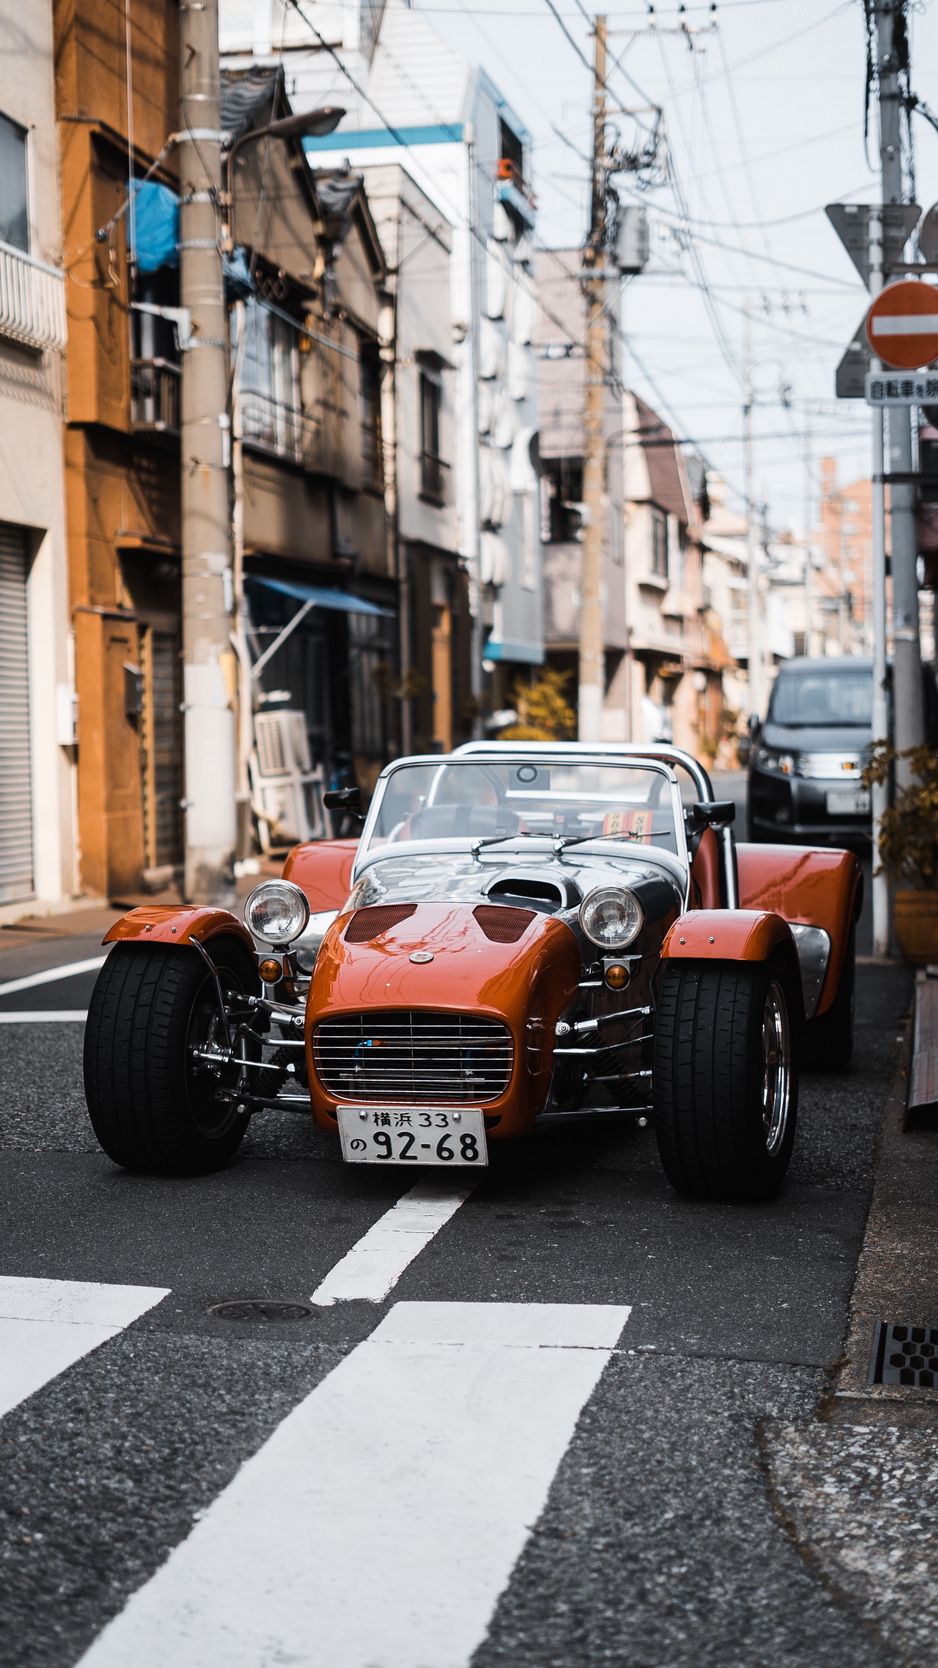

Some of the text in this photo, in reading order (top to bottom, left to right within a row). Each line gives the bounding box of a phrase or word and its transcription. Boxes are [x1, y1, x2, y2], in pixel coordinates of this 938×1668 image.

[373, 1112, 449, 1128] 横浜 33
[350, 1131, 479, 1161] の 92-68
